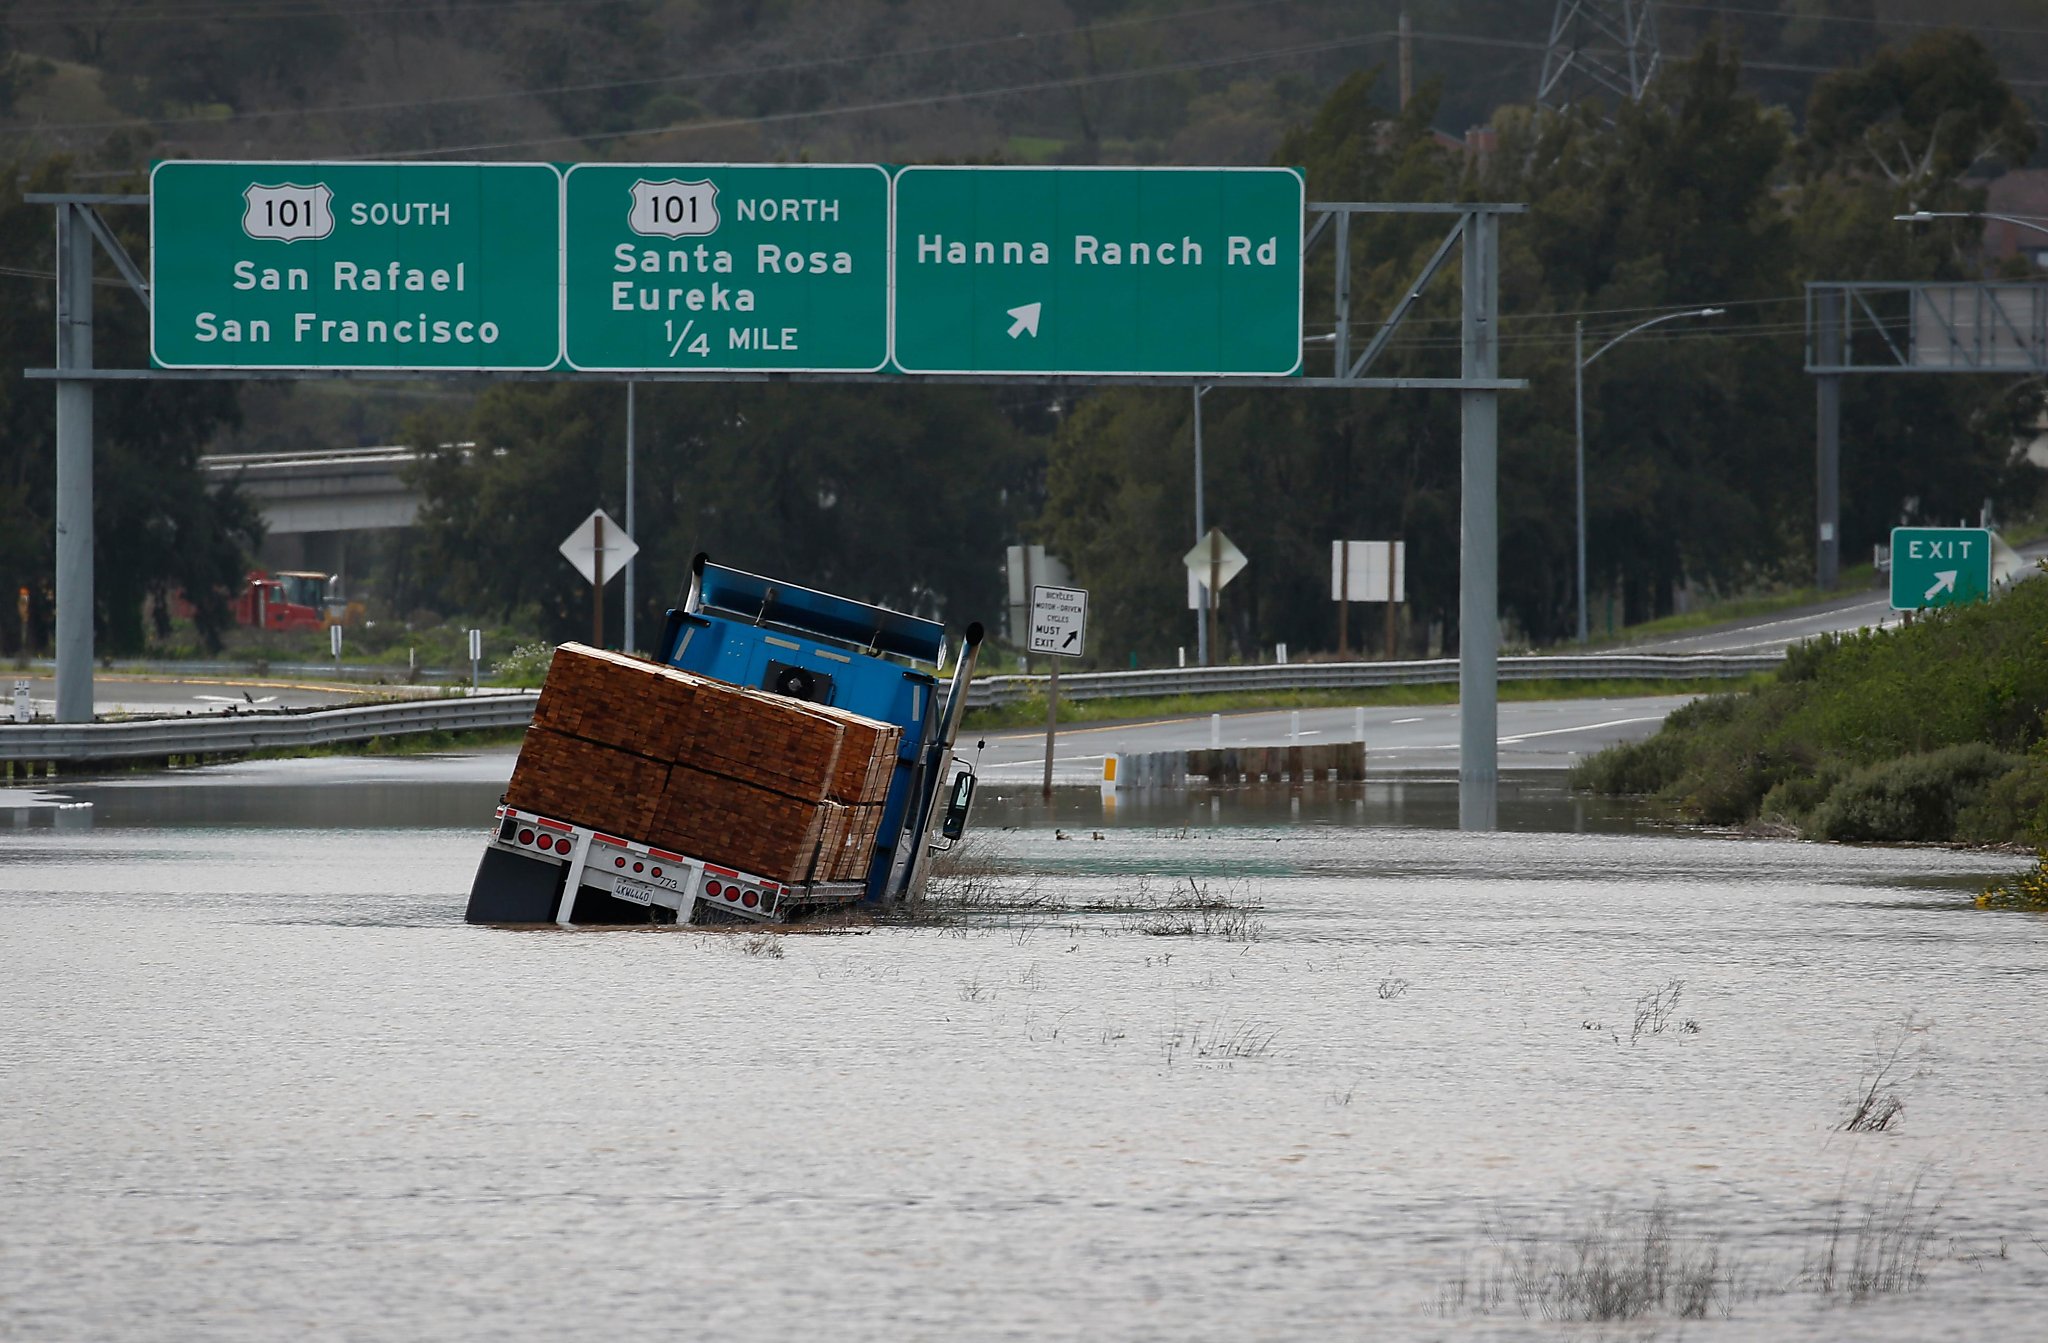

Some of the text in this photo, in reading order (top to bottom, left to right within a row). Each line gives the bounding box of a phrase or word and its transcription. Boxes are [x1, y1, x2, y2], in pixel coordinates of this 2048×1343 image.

[265, 199, 450, 227] 101 SOUTH
[651, 195, 839, 224] 101 NORTH
[614, 243, 852, 274] Santa Rosa
[918, 234, 1277, 266] Hanna Ranch Rd
[233, 260, 464, 291] San Rafael
[612, 281, 755, 312] Eureka
[194, 312, 499, 344] San Francisco
[729, 327, 798, 351] MILE
[1909, 540, 1972, 559] EXIT
[1046, 592, 1074, 601] BICYCLES
[1036, 625, 1060, 635] MUST
[1047, 615, 1069, 623] CYCLES
[1035, 638, 1054, 647] EXIT
[659, 877, 677, 888] 773
